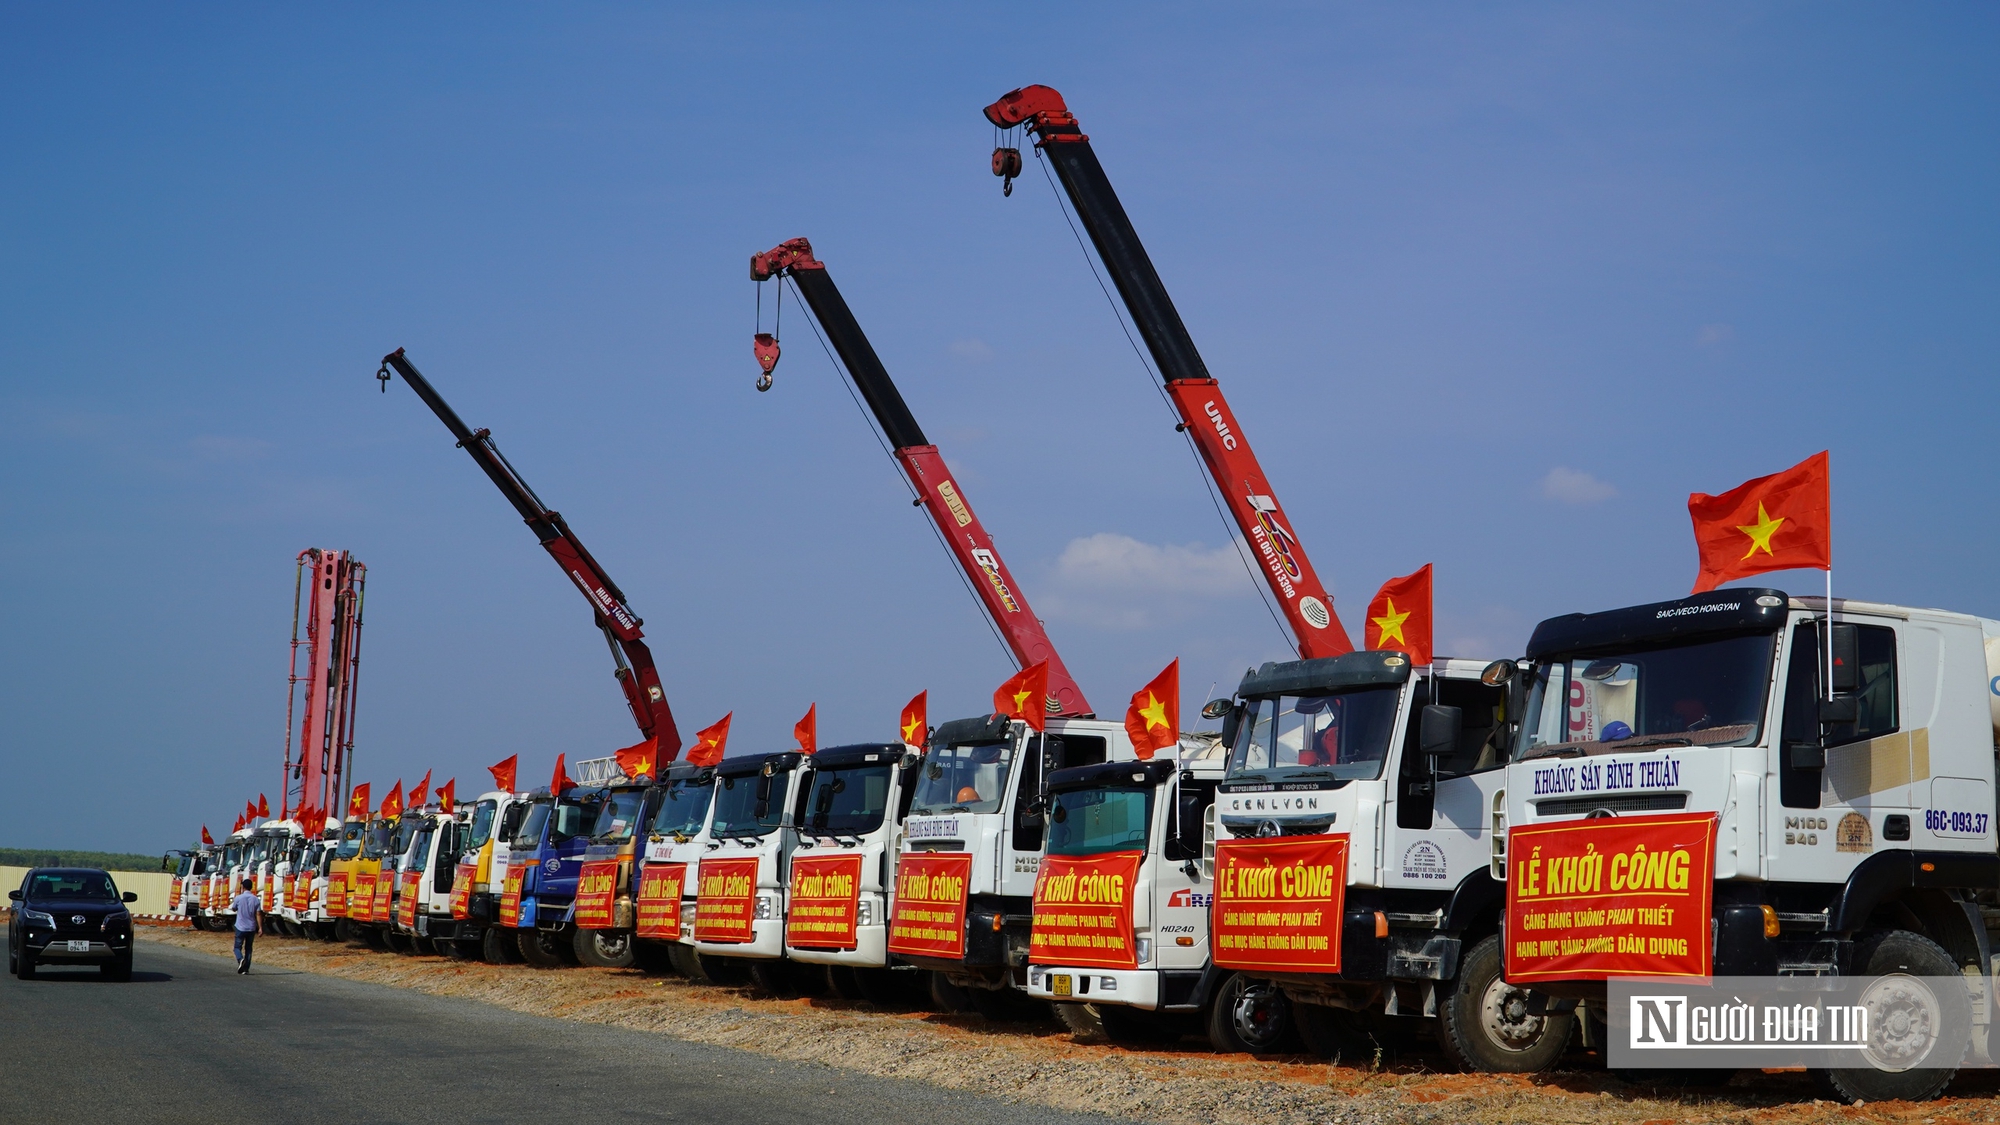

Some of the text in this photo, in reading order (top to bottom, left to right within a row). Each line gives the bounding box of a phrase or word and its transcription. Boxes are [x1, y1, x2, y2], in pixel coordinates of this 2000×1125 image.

[1204, 400, 1237, 451] UNIC
[941, 484, 969, 526] UNIC
[1260, 541, 1296, 599] 0911313399
[595, 587, 613, 606] HIAB
[612, 606, 634, 631] 140AW
[1656, 602, 1741, 619] SAIC-IVECO HONGYAN
[1534, 754, 1680, 795] KHOÁNG SẢN BÌNH THUẬN
[1232, 797, 1318, 811] GENLYON
[1785, 816, 1828, 831] M100
[1925, 809, 1989, 834] 86C-093.37
[1785, 833, 1818, 846] 340
[1015, 865, 1038, 873] 290
[1220, 857, 1334, 898] LỄ KHỞI CÔNG
[1518, 843, 1691, 897] LỄ KHỞI CÔNG
[724, 871, 751, 897] CÔNG
[825, 870, 852, 897] CÔNG
[907, 867, 929, 899] KHỞI
[931, 871, 963, 901] CÔNG
[1044, 867, 1077, 902] KHỞI
[1078, 869, 1124, 903] CÔNG
[1057, 912, 1078, 927] KHÔNG
[1079, 915, 1098, 927] PHAN
[1099, 912, 1116, 928] THIẾT
[1256, 910, 1281, 927] KHÔNG
[1281, 912, 1302, 926] PHAN
[1302, 908, 1322, 926] THIẾT
[1523, 903, 1674, 930] CẢNG HÀNG KHÔNG PHAN THIẾT
[1066, 933, 1091, 948] KHÔNG
[1092, 933, 1106, 948] DÂN
[1107, 935, 1125, 951] DỤNG
[1266, 933, 1290, 950] KHÔNG
[1291, 933, 1306, 950] DÂN
[1307, 935, 1328, 953] DỤNG
[1516, 933, 1688, 960] HẠNG MỤC HÀNG KHÔNG DÂN DỤNG
